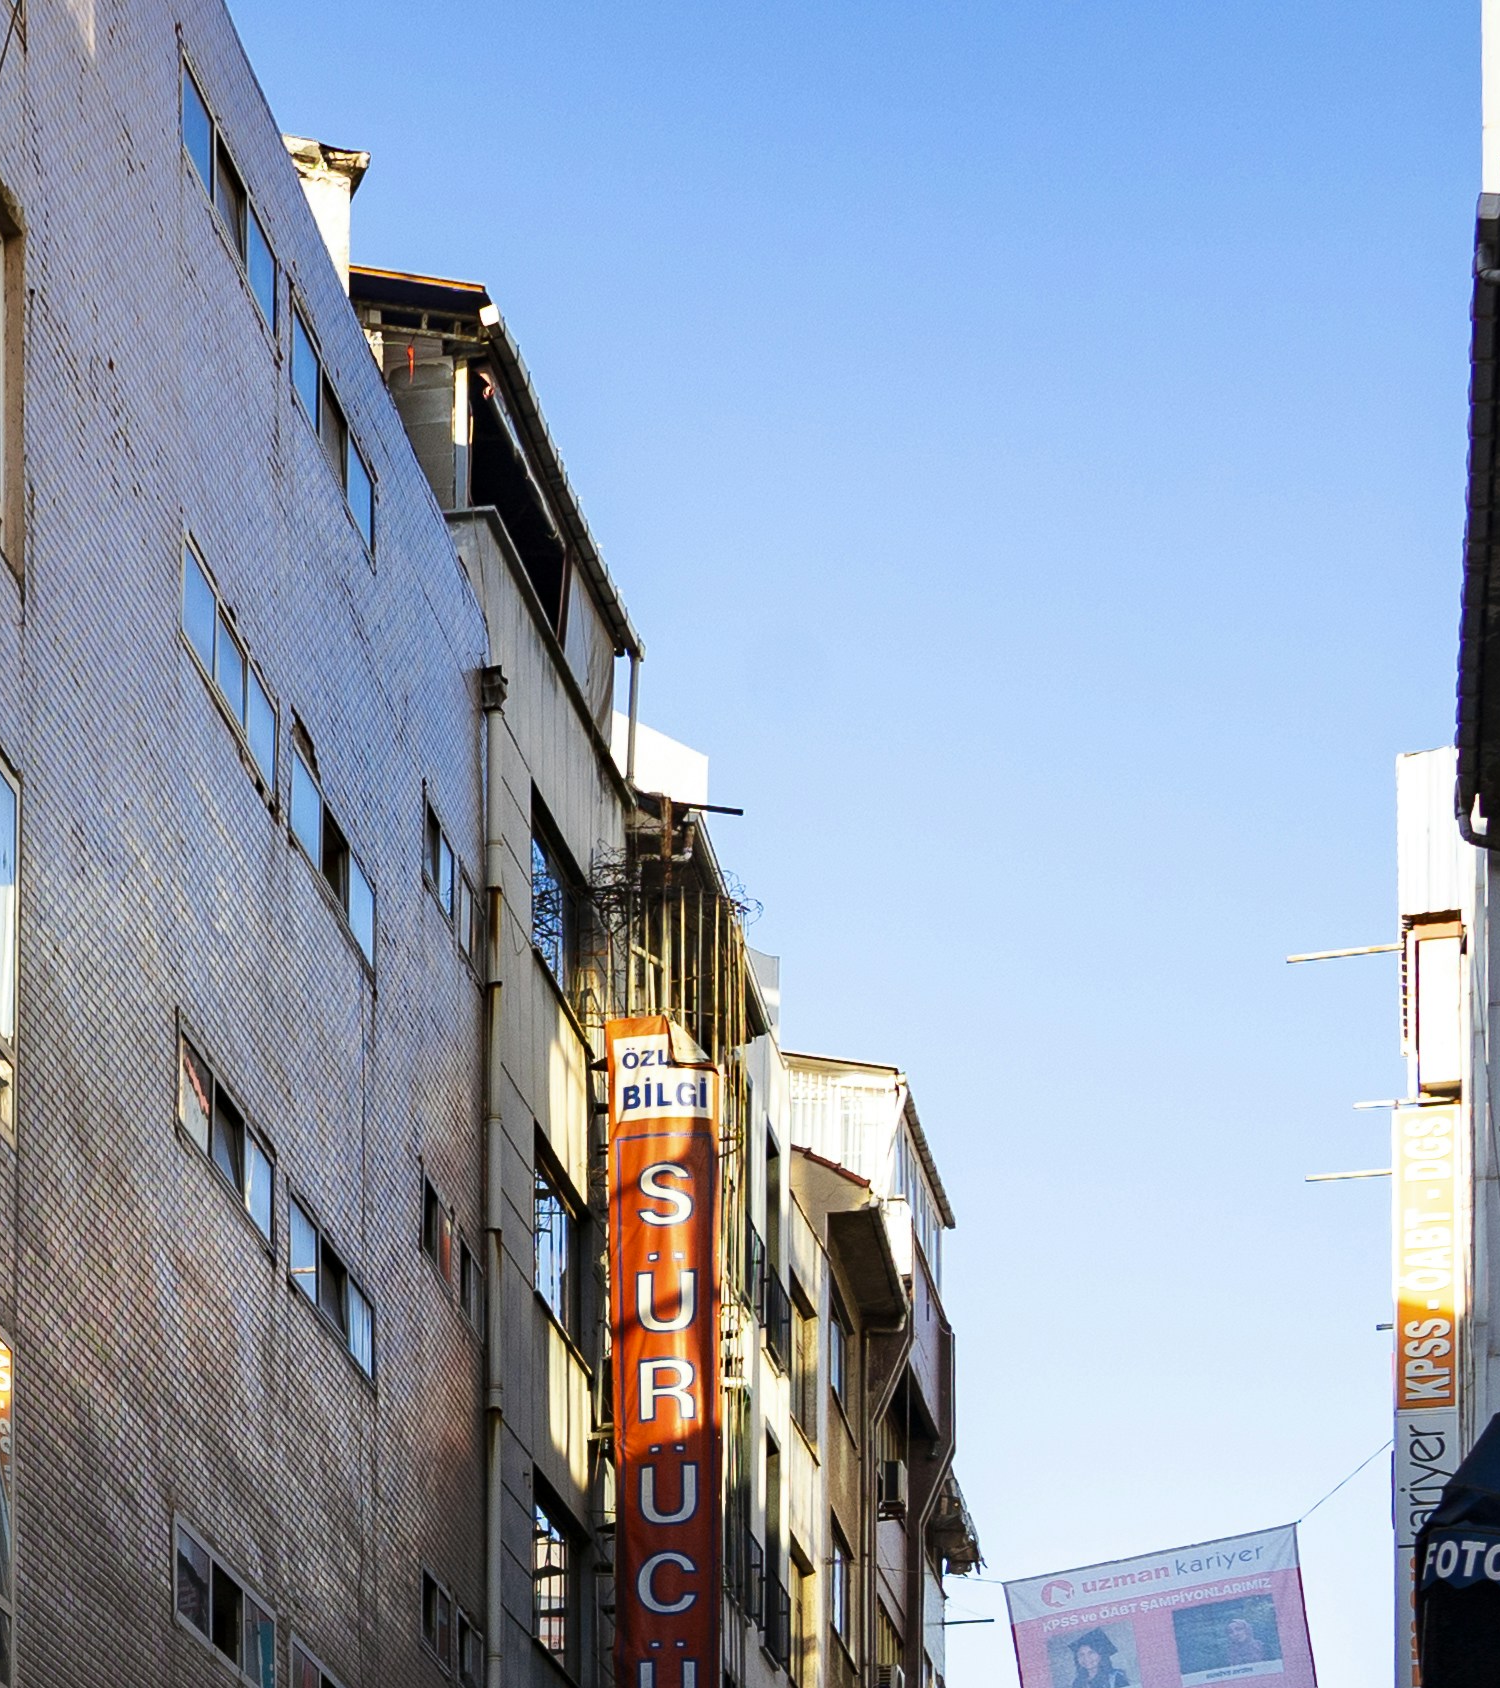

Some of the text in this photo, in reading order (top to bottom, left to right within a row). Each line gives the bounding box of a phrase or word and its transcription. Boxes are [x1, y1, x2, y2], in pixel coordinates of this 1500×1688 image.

[623, 1077, 707, 1110] BİLGİ
[1400, 1116, 1452, 1401] KPSS ÖABT DGS
[1082, 1545, 1264, 1594] uzman kariyer
[1042, 1613, 1079, 1632] KPSS
[1139, 1577, 1272, 1614] ŞAMPİYONLARIMIZ
